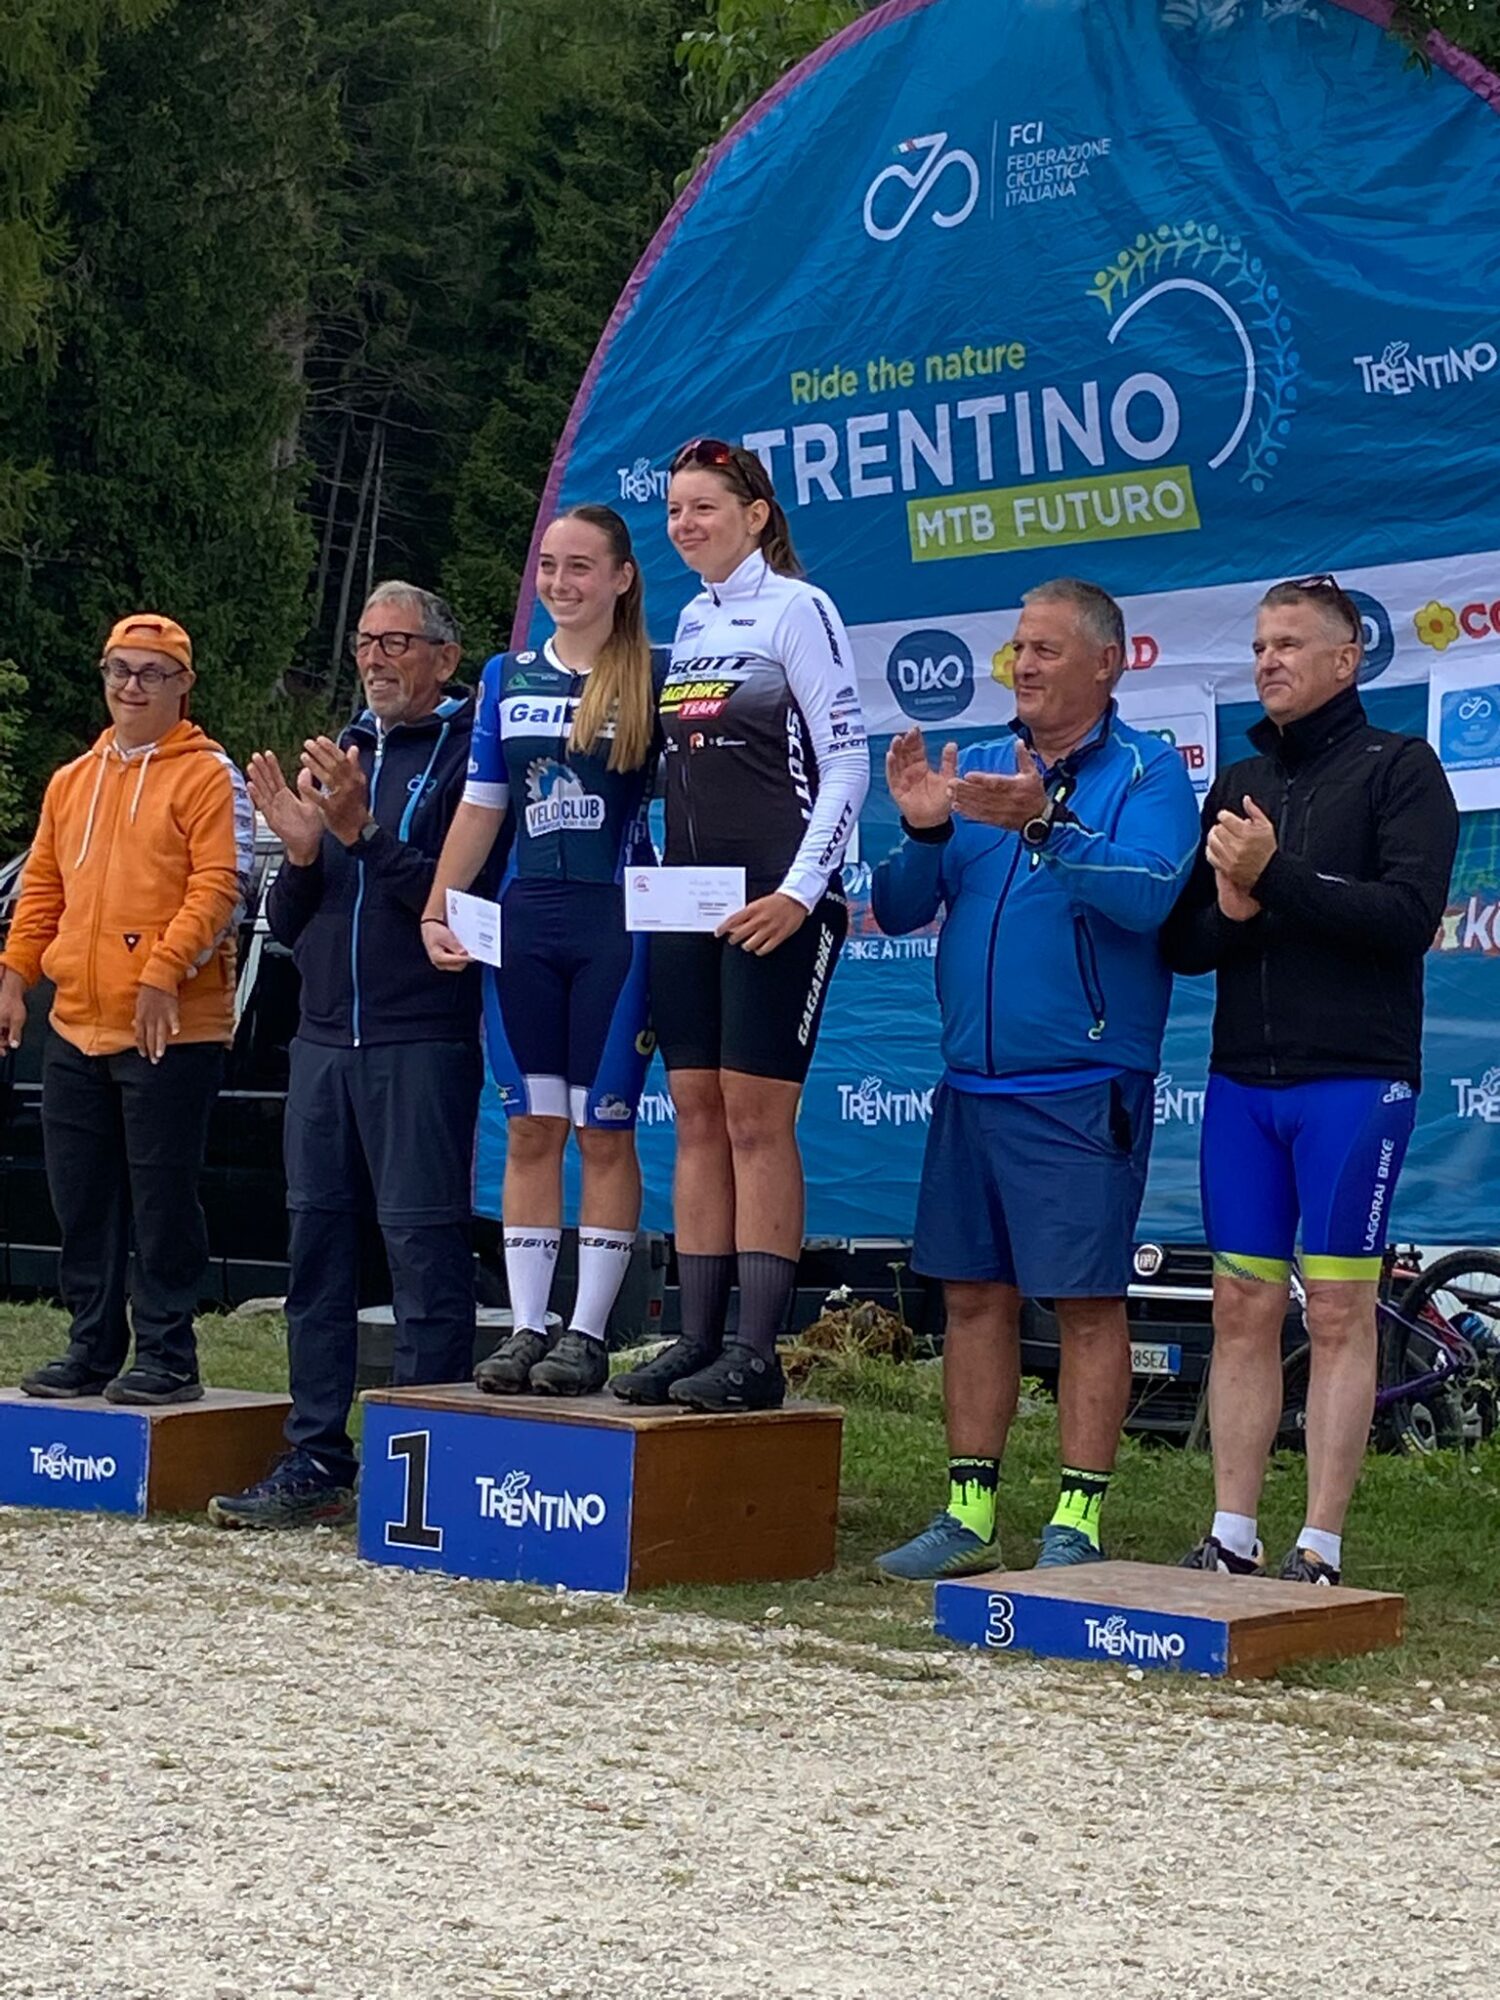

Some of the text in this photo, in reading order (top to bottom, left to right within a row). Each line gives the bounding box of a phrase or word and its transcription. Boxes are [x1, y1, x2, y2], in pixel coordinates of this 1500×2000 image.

[1007, 138, 1112, 172] FEDERAZIONE
[1009, 121, 1043, 148] FCI
[1005, 180, 1077, 207] ITALIANA
[1006, 161, 1090, 189] CICLISTICA
[790, 341, 1026, 405] Ride the nature
[1353, 342, 1498, 395] TRENTINO
[742, 372, 1180, 506] TRENTINO
[917, 480, 1186, 549] MTB FUTURO
[898, 654, 965, 692] DAO
[1363, 1138, 1395, 1251] LAGORAI BIKE
[29, 1446, 117, 1482] TRENTINO
[385, 1430, 607, 1552] 1 TRENTINO
[985, 1594, 1187, 1661] 3 TRENTINO
